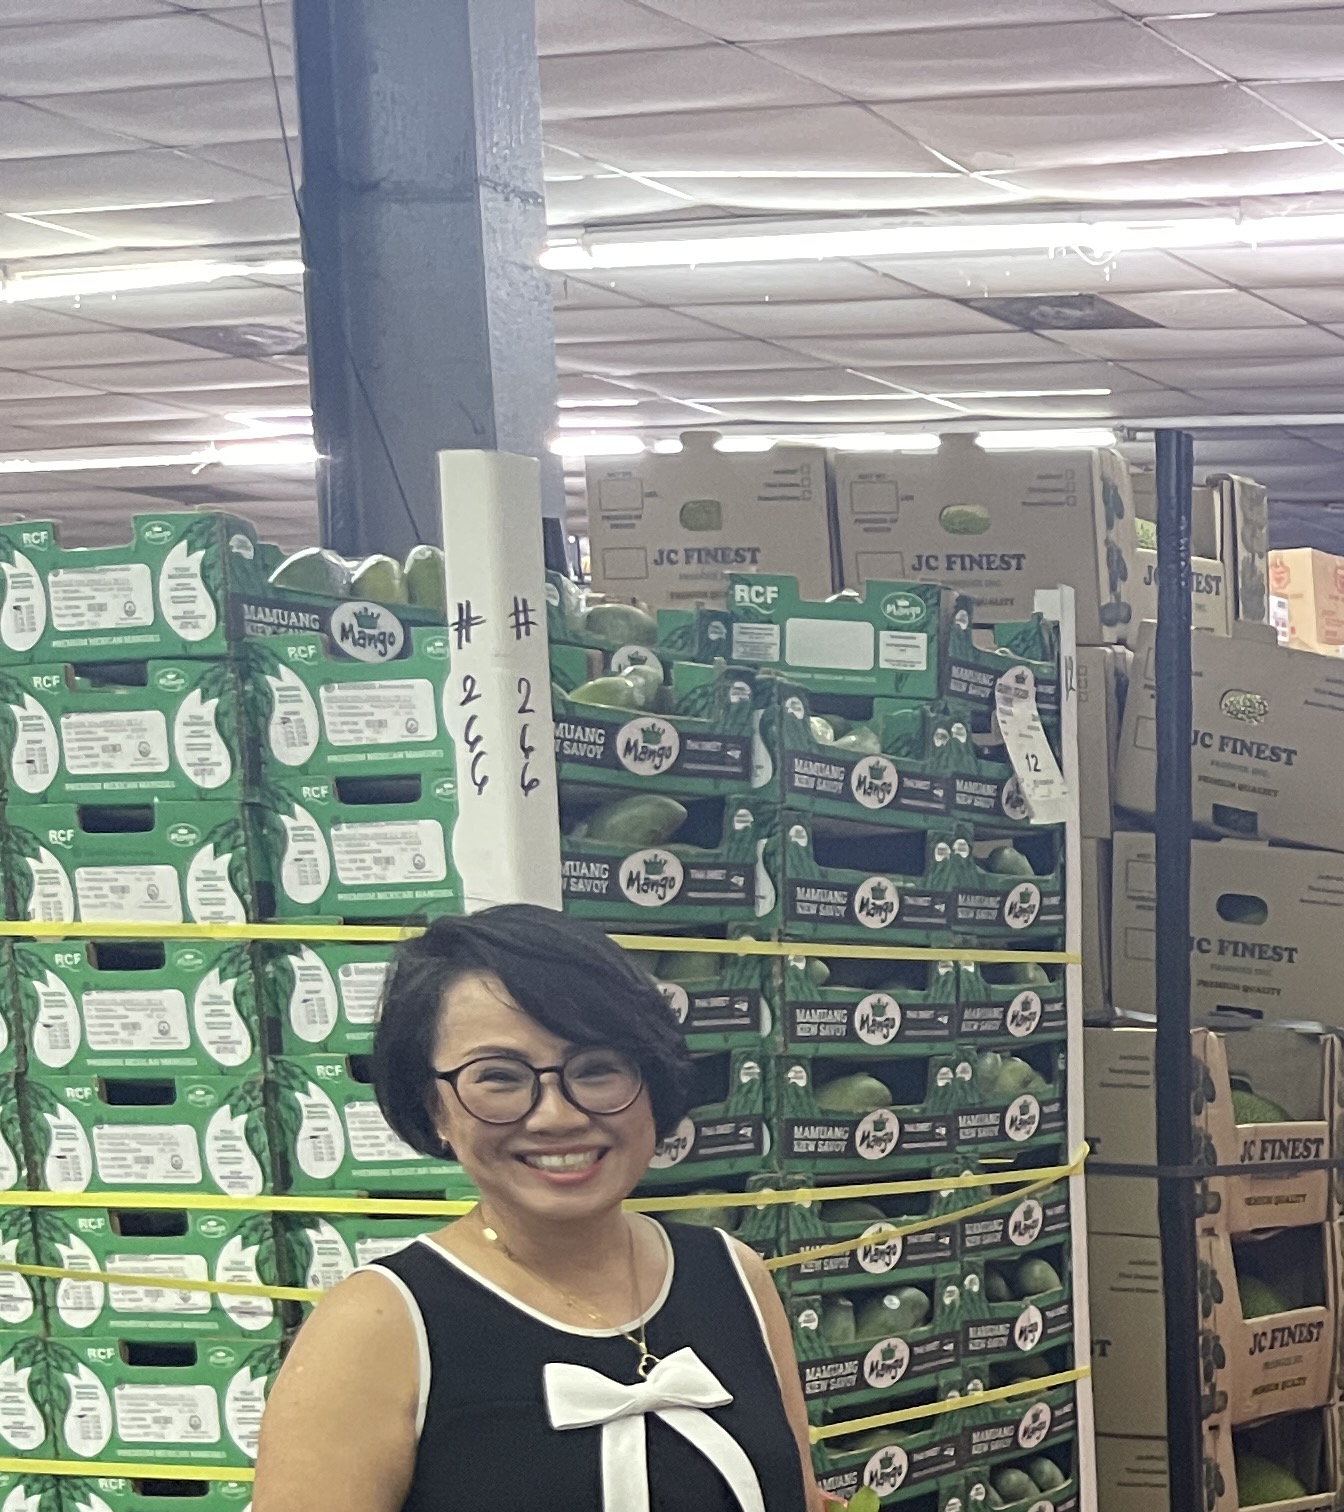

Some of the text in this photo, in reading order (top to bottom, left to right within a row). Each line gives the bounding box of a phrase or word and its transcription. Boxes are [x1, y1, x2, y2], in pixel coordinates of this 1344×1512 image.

[23, 531, 48, 544] RCF
[653, 546, 762, 566] JC FINEST
[911, 553, 1027, 571] JC FINEST
[734, 584, 779, 604] RCF
[243, 603, 320, 630] MAMUANG
[340, 622, 397, 658] Mango
[288, 645, 316, 658] RCF
[33, 676, 60, 688] RCF
[563, 740, 604, 759] SAVOY
[623, 737, 673, 771] Mango
[1191, 729, 1298, 767] JC FINEST
[1025, 752, 1042, 773] 12
[302, 785, 329, 798] RCF
[856, 773, 893, 804] Mango
[49, 829, 75, 842] RCF
[569, 877, 609, 895] SAVOY
[626, 869, 676, 900] Mango
[858, 895, 895, 924] Mango
[54, 953, 81, 965] RCF
[1190, 936, 1299, 965] JC FINEST
[859, 1013, 896, 1040] Mango
[316, 1064, 343, 1078] RCF
[65, 1086, 92, 1099] RCF
[793, 1124, 850, 1141] MAMUANG
[858, 1128, 894, 1154] Mango
[817, 1139, 848, 1153] SAVOY
[1240, 1137, 1324, 1164] JC FINEST
[78, 1217, 105, 1230] RCF
[863, 1240, 898, 1266] Mango
[1248, 1321, 1325, 1356] JC FINEST
[868, 1356, 904, 1380] Mango
[817, 1470, 858, 1492] AMUANG
[870, 1463, 903, 1488] Mango
